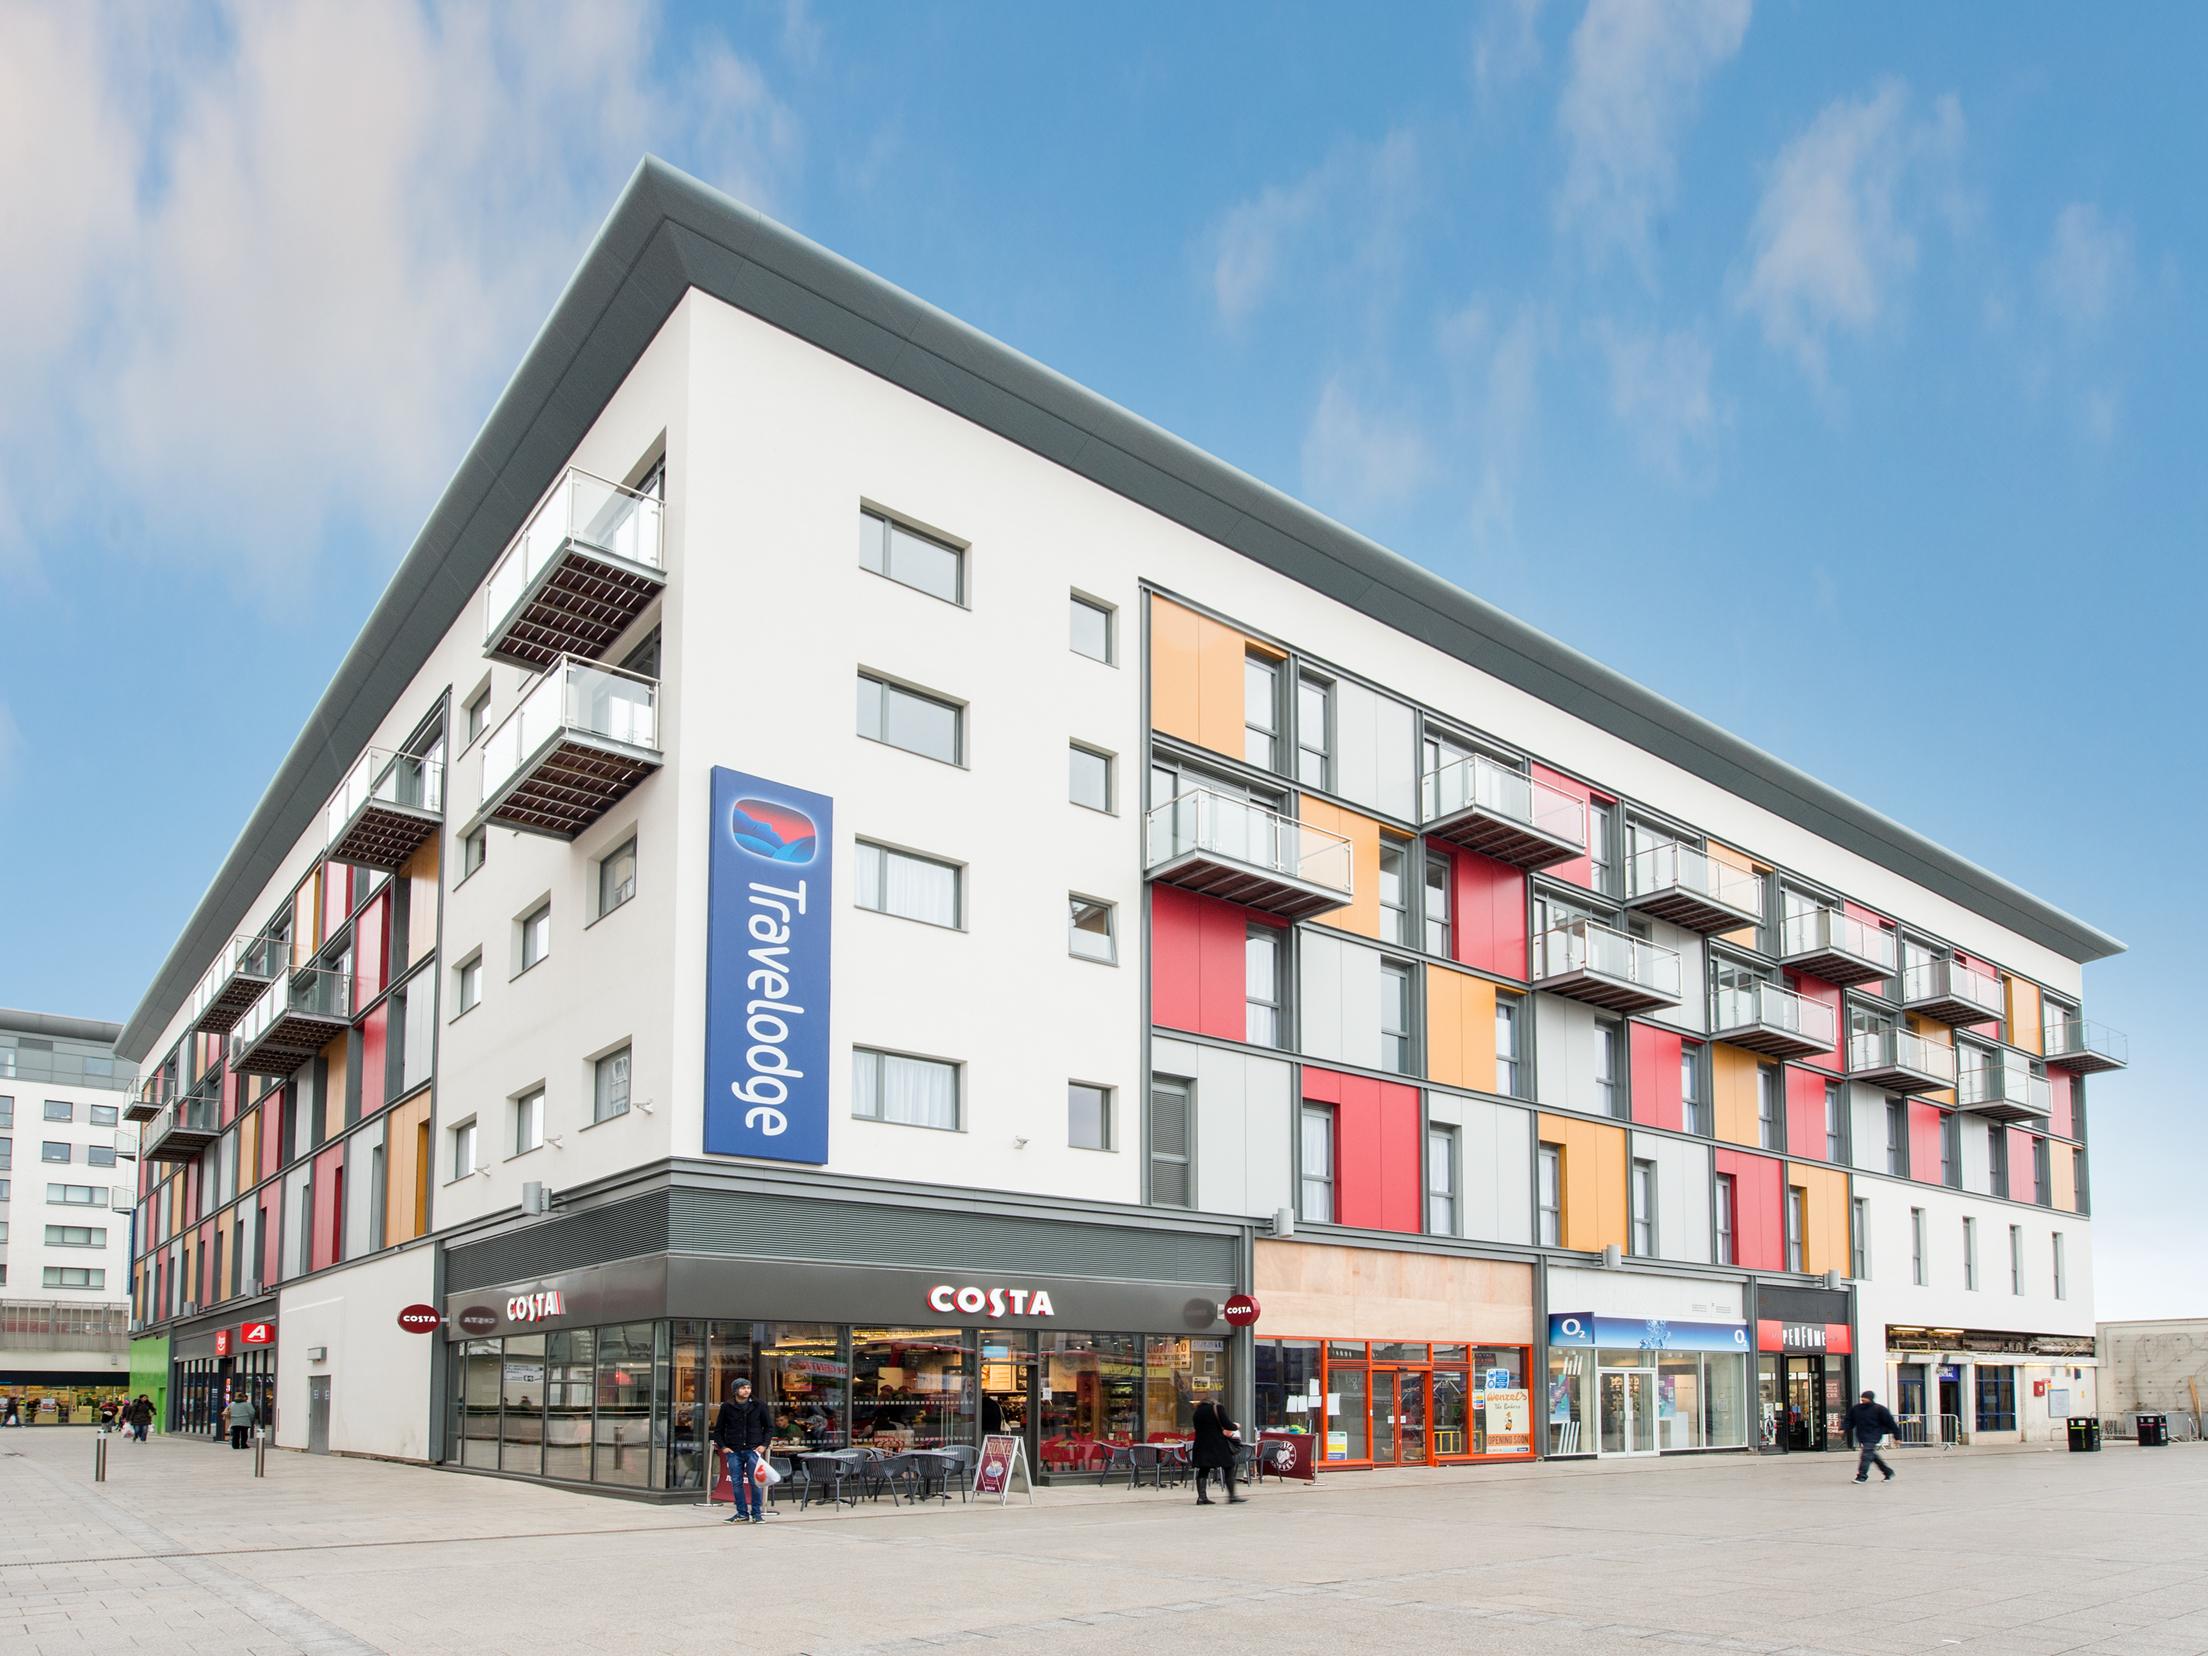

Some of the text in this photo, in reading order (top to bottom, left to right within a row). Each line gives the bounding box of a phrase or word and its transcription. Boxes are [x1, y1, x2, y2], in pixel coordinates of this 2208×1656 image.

[730, 880, 807, 1137] Travelodge
[506, 1290, 566, 1322] COSTA
[926, 1285, 1056, 1319] COSTA
[1226, 1306, 1252, 1314] COSTA
[402, 1315, 437, 1324] COSTA
[1782, 1326, 1827, 1349] PERFUME
[1488, 1432, 1529, 1446] OPENING SOON
